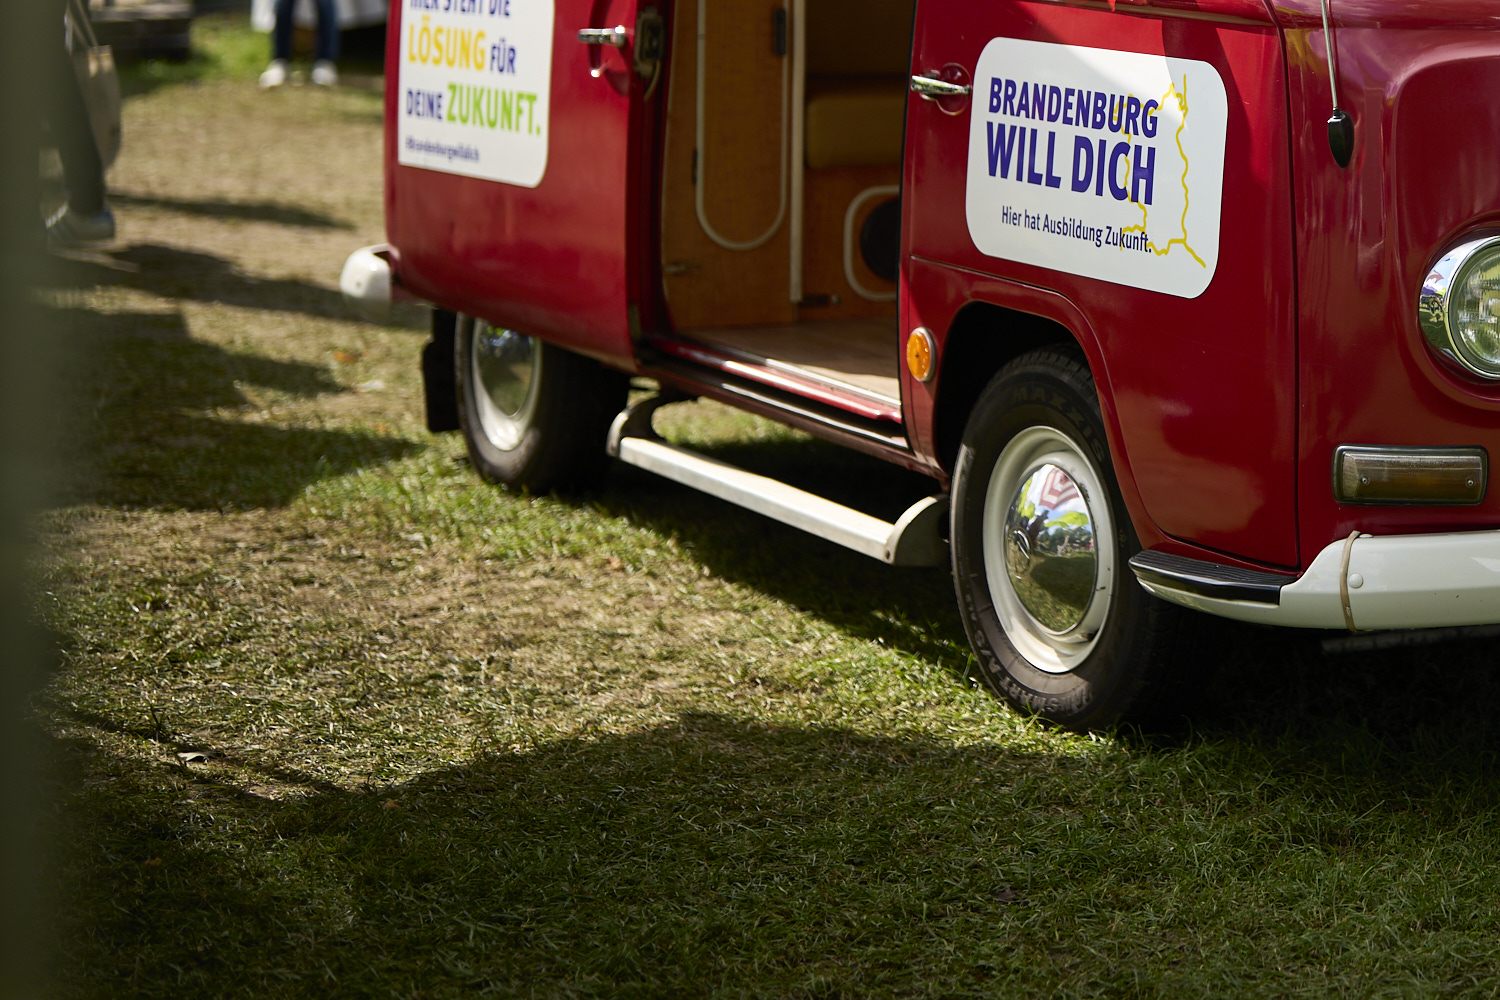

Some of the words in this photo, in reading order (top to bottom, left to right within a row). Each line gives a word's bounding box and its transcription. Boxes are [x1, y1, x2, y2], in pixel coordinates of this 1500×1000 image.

[408, 14, 486, 71] LÖSUNG
[490, 37, 517, 74] FÜR
[406, 88, 443, 120] DEINE
[447, 82, 541, 136] ZUKUNFT.
[988, 77, 1159, 138] BRANDENBURG
[986, 121, 1061, 189] WILL
[1071, 135, 1156, 205] DICH
[1001, 205, 1022, 226] Hier
[1024, 209, 1040, 231] hat
[1042, 213, 1103, 248] Ausbildung
[1105, 225, 1152, 253] Zukunft.
[1013, 386, 1104, 462] MAXXIS
